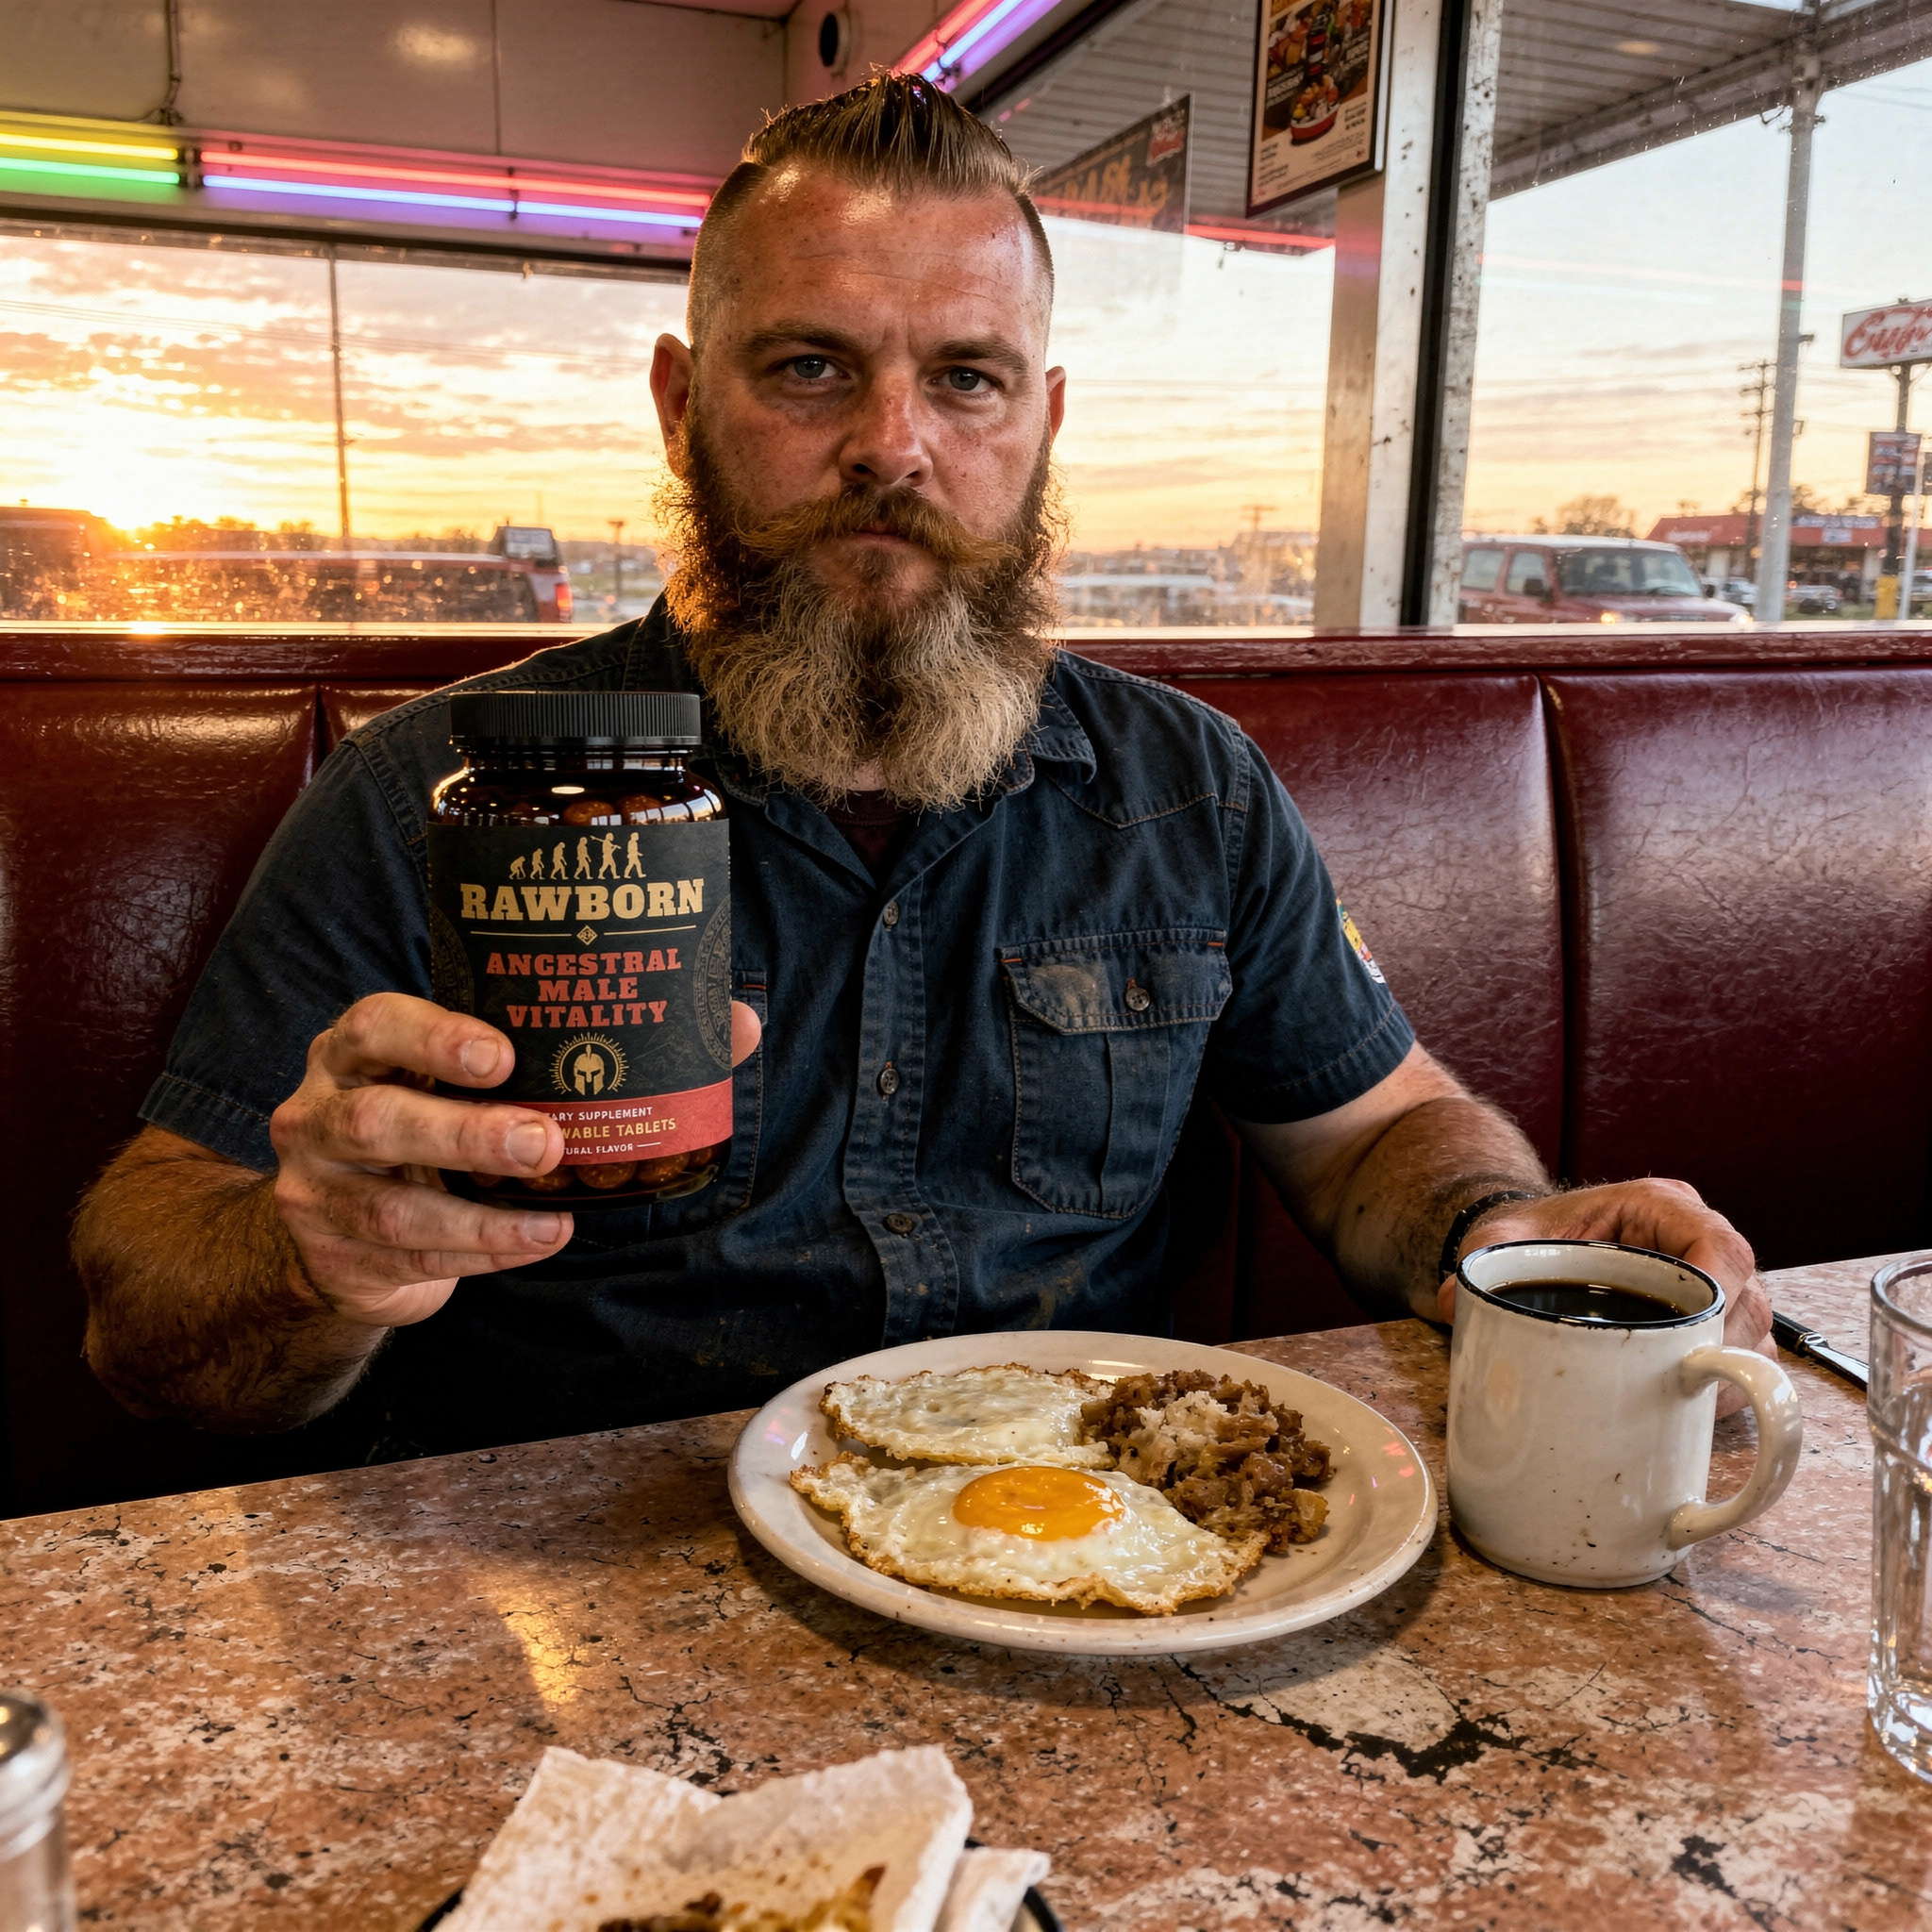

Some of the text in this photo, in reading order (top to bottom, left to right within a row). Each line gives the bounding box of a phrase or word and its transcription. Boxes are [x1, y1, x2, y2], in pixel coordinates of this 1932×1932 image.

[460, 878, 705, 921] RAWBORN
[486, 948, 682, 975] ANCESTRAL
[538, 977, 639, 1002] MALE
[506, 1000, 668, 1028] VITALITY
[578, 1106, 653, 1121] SUPPLEMENT
[561, 1118, 676, 1139] WABLE TABLETS
[595, 1143, 634, 1154] FLAVOR
